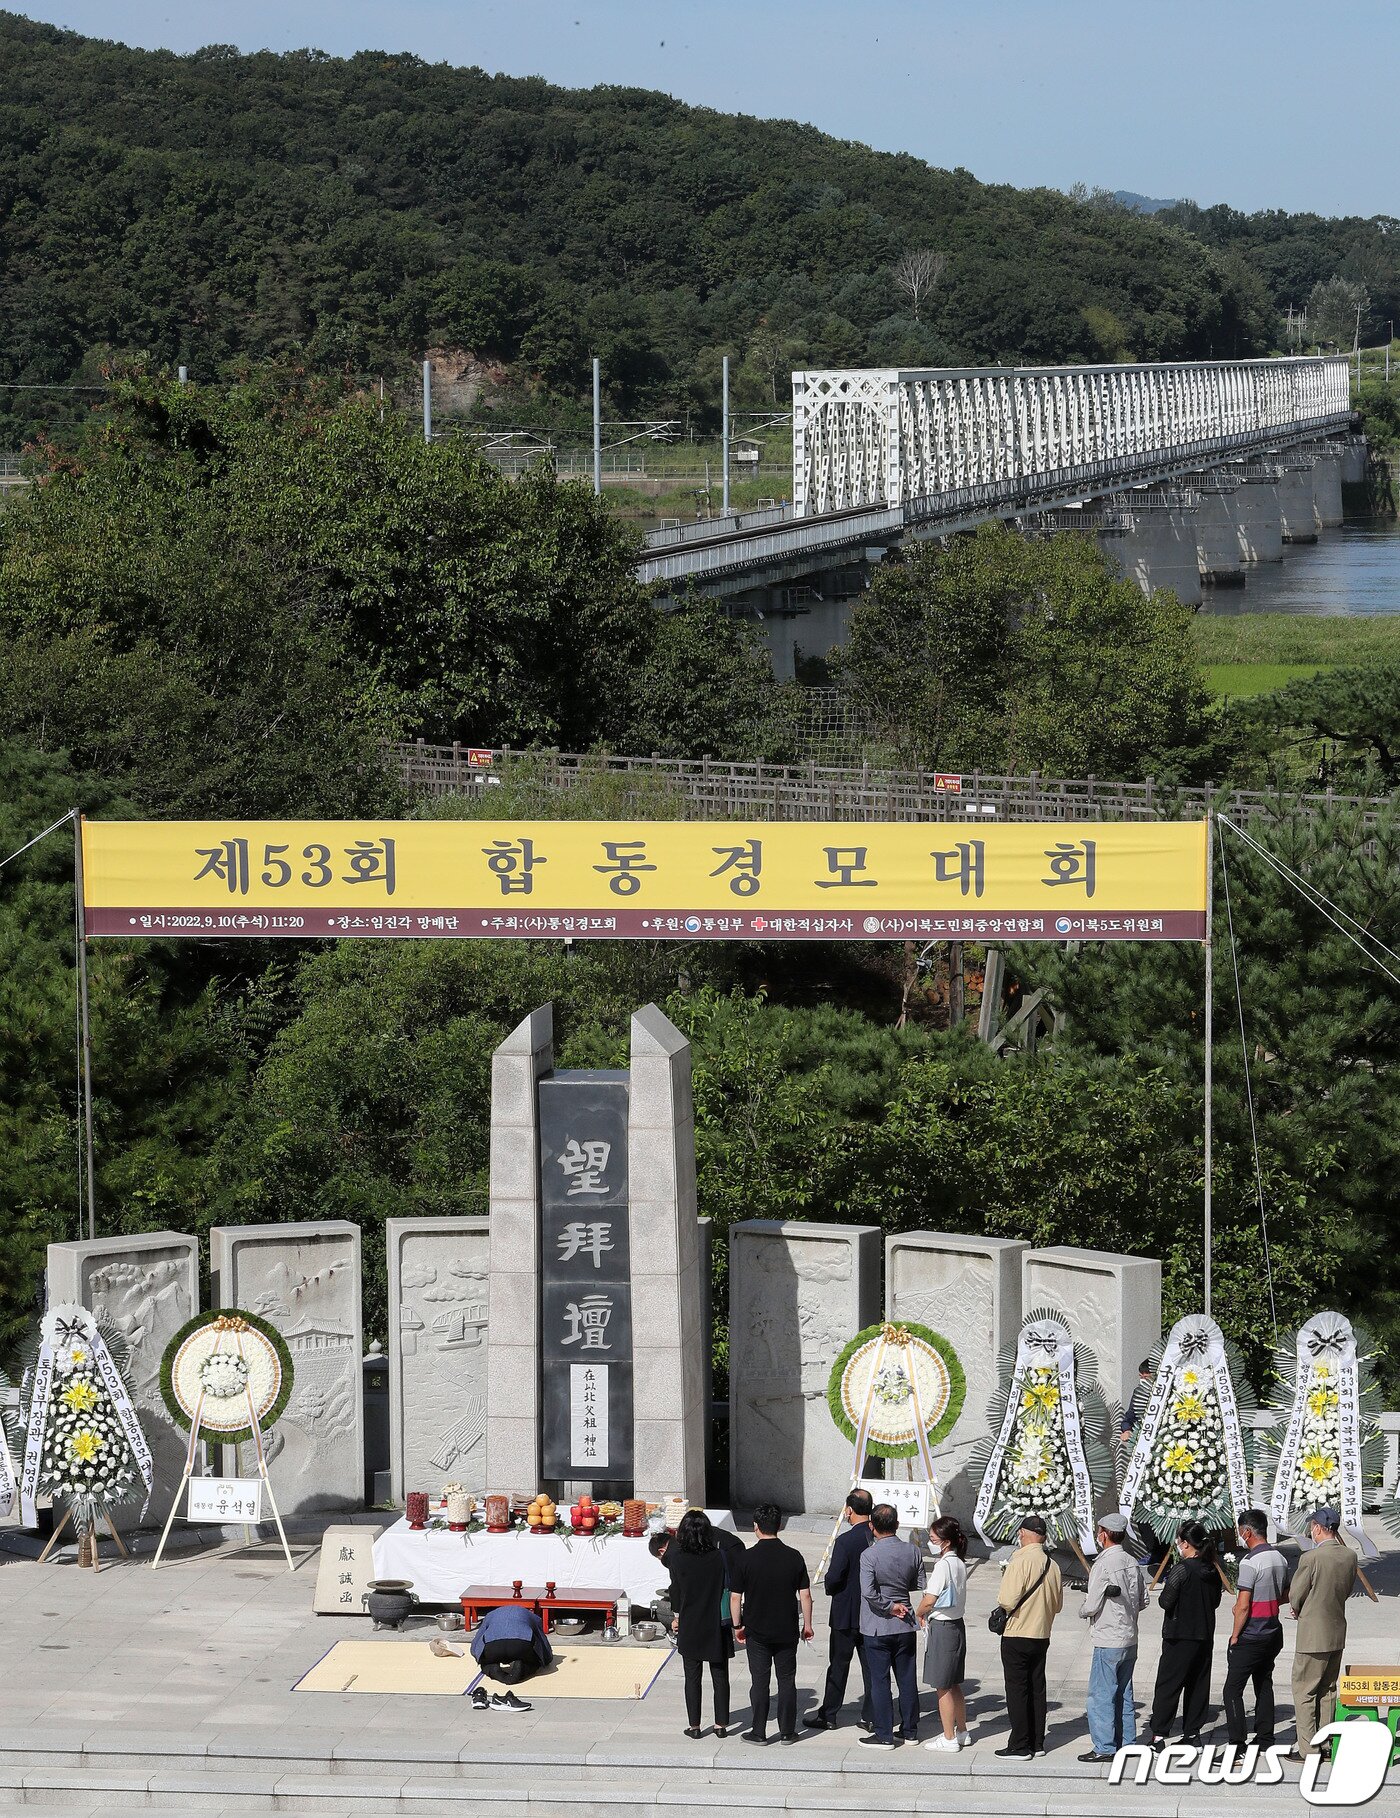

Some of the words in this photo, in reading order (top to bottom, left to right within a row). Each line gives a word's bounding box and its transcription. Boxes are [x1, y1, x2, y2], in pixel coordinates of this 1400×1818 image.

[193, 837, 397, 896] 제53회
[271, 915, 305, 928] 11:20
[416, 916, 460, 930] 망배단
[769, 917, 854, 932] 대한적십자사
[1072, 917, 1164, 933] 이북5도위원회
[1142, 1365, 1174, 1442] 국회의원
[1120, 1451, 1146, 1507] 한기호
[216, 1499, 256, 1516] 윤석열
[1342, 1681, 1370, 1691] 제53회
[1373, 1681, 1400, 1692] 합동경
[1381, 1695, 1400, 1703] 통일경
